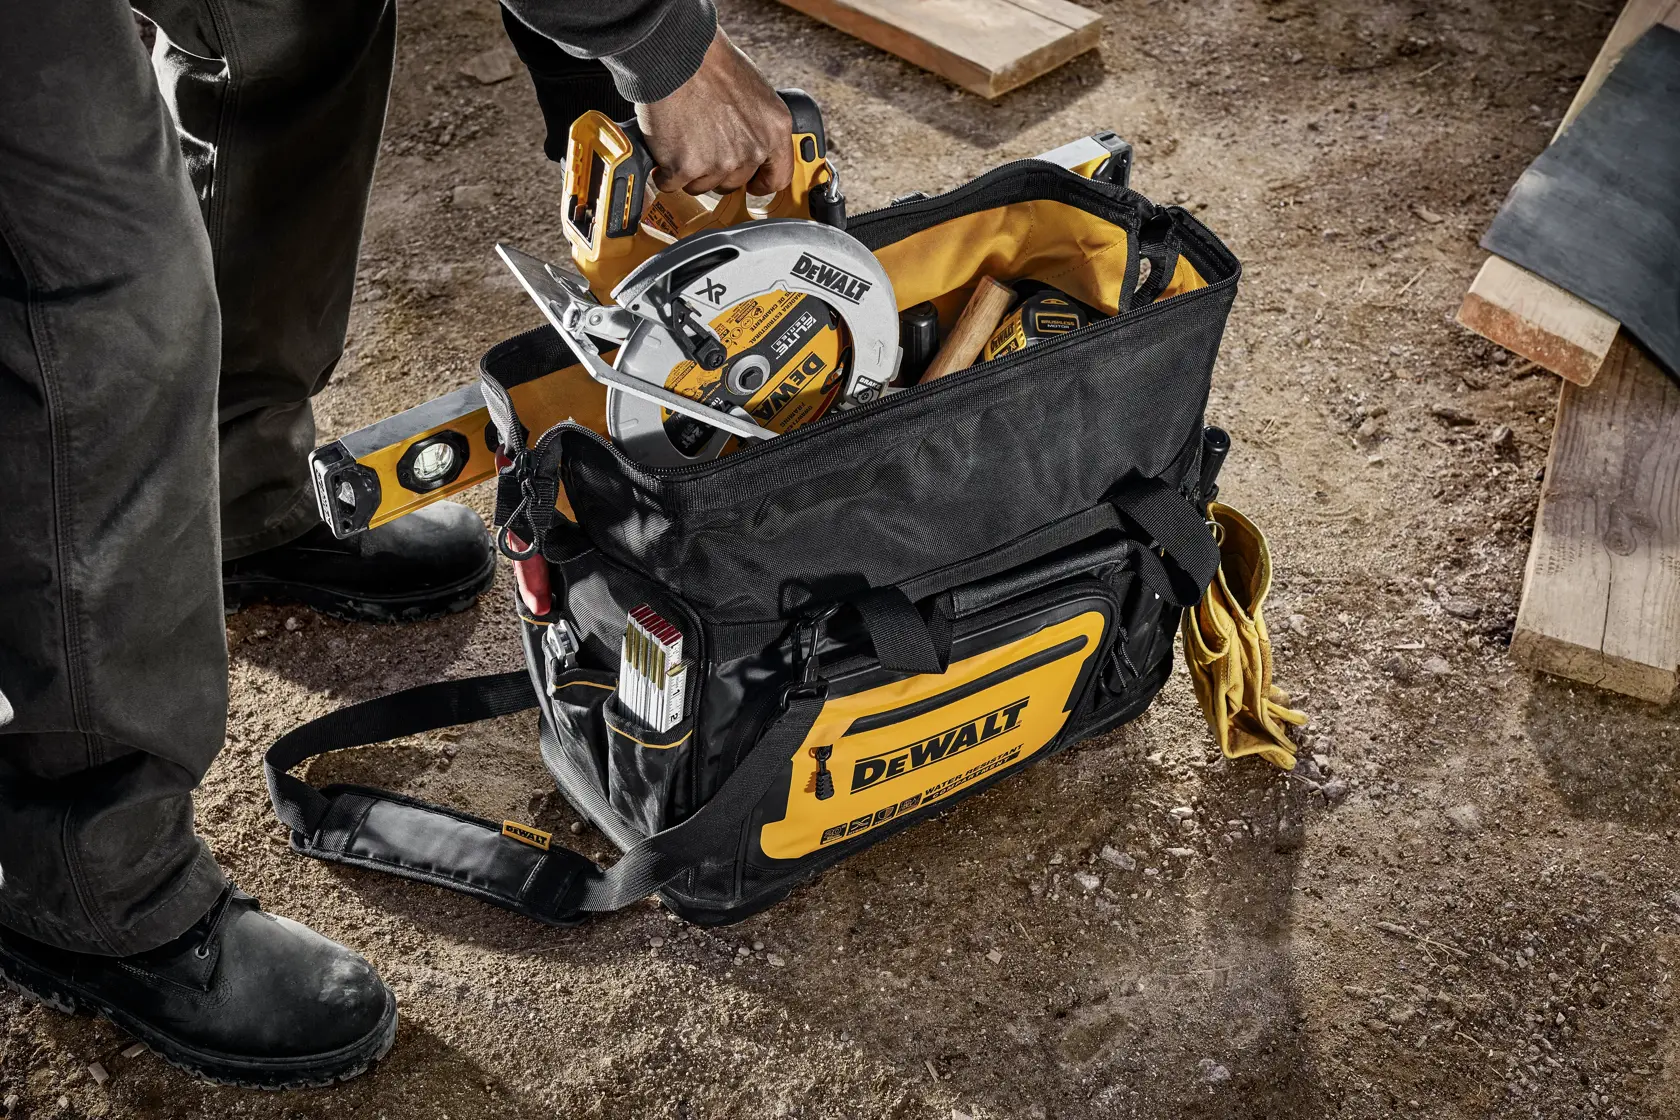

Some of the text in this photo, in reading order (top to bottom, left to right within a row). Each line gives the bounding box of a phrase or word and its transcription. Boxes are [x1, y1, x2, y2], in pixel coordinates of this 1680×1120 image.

[791, 254, 872, 302] DEWALT
[749, 312, 782, 344] ESTRUCTURAL
[750, 304, 778, 332] CHARPENTE
[776, 316, 807, 346] SERIES
[776, 316, 817, 356] ELITE
[751, 353, 825, 425] DEWA
[779, 402, 806, 428] FRAMING
[851, 699, 1029, 791] DEWALT
[925, 742, 1025, 796] WATER RESISTANT
[506, 825, 547, 846] DEWALT
